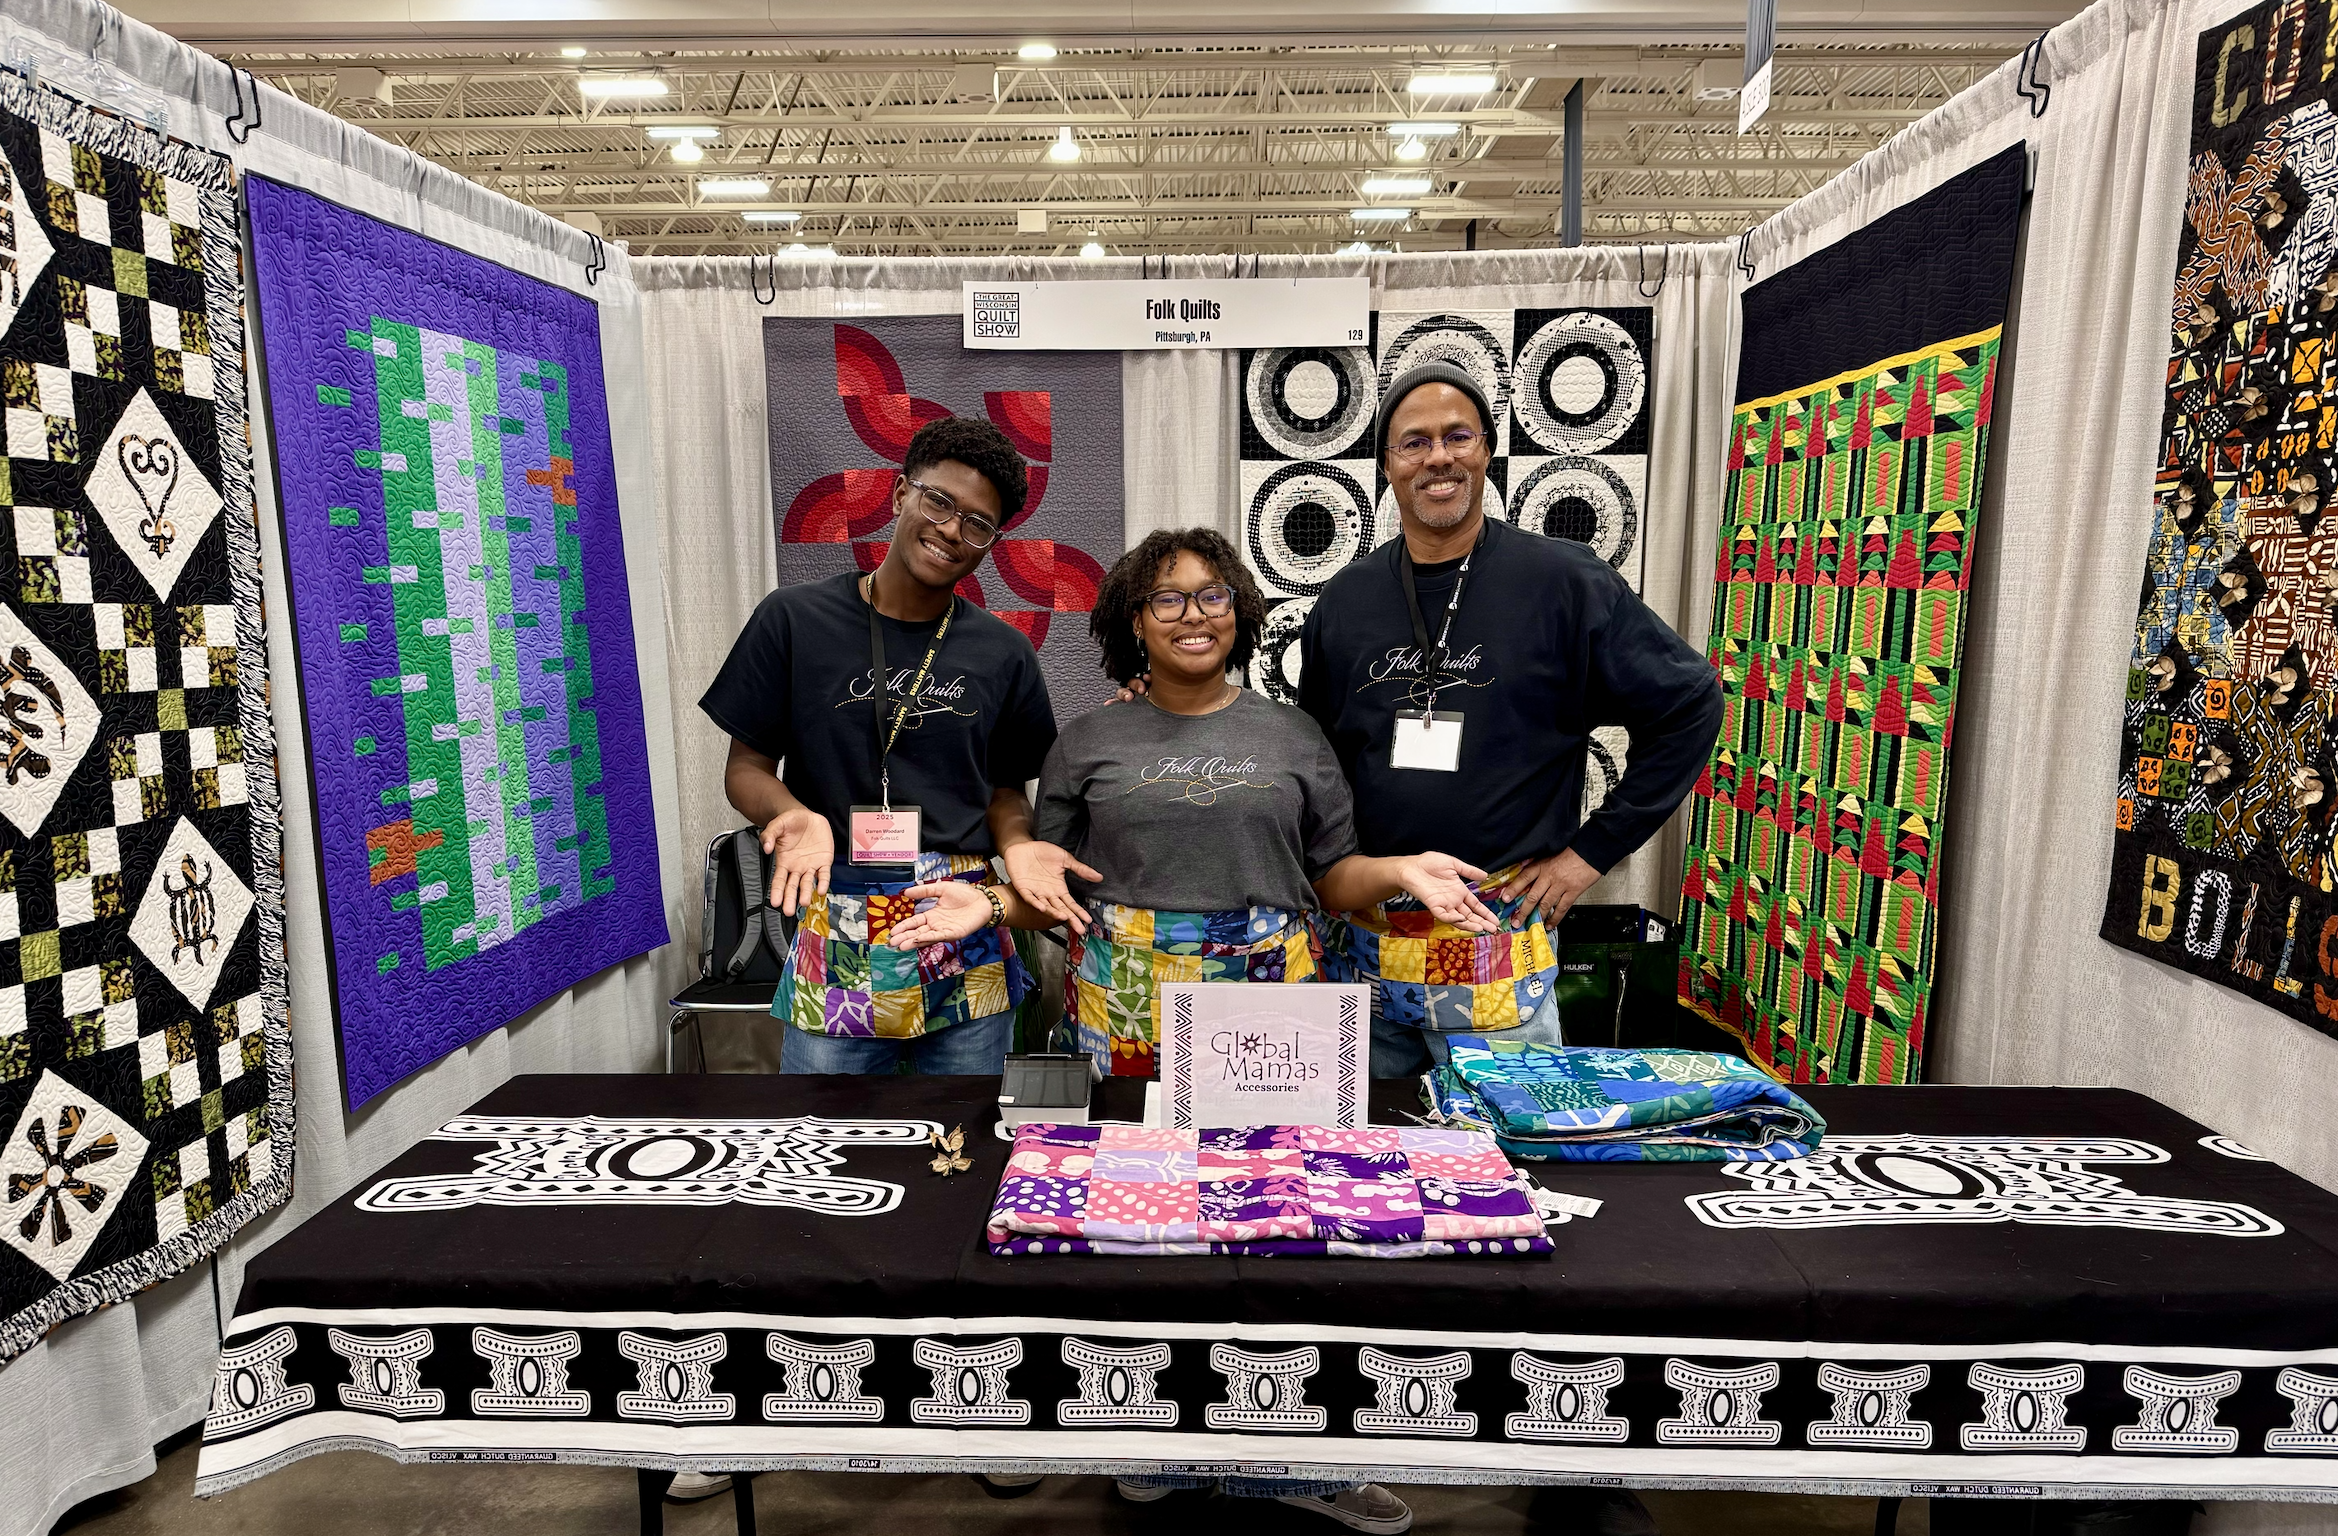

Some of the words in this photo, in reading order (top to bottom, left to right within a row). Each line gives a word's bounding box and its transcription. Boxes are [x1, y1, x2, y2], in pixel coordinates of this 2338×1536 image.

[977, 310, 1017, 322] QUILT
[1146, 299, 1175, 320] Folk
[1180, 299, 1221, 322] Quilts
[977, 324, 1017, 335] SHOW
[1155, 331, 1198, 343] Pittsburgh,
[1200, 331, 1211, 342] PA
[1348, 330, 1364, 341] 129
[921, 648, 936, 671] SAFETY
[1369, 645, 1423, 680] Folk
[909, 668, 926, 697] MATTERS
[893, 706, 908, 730] SAFETY
[1141, 757, 1205, 781] Folk
[1201, 755, 1258, 785] Quilts
[1521, 939, 1540, 995] MICHAEL
[1564, 963, 1593, 971] HULKEN
[1210, 1030, 1299, 1061] Global
[1222, 1057, 1319, 1081] Mamas
[1234, 1082, 1300, 1093] Accessories
